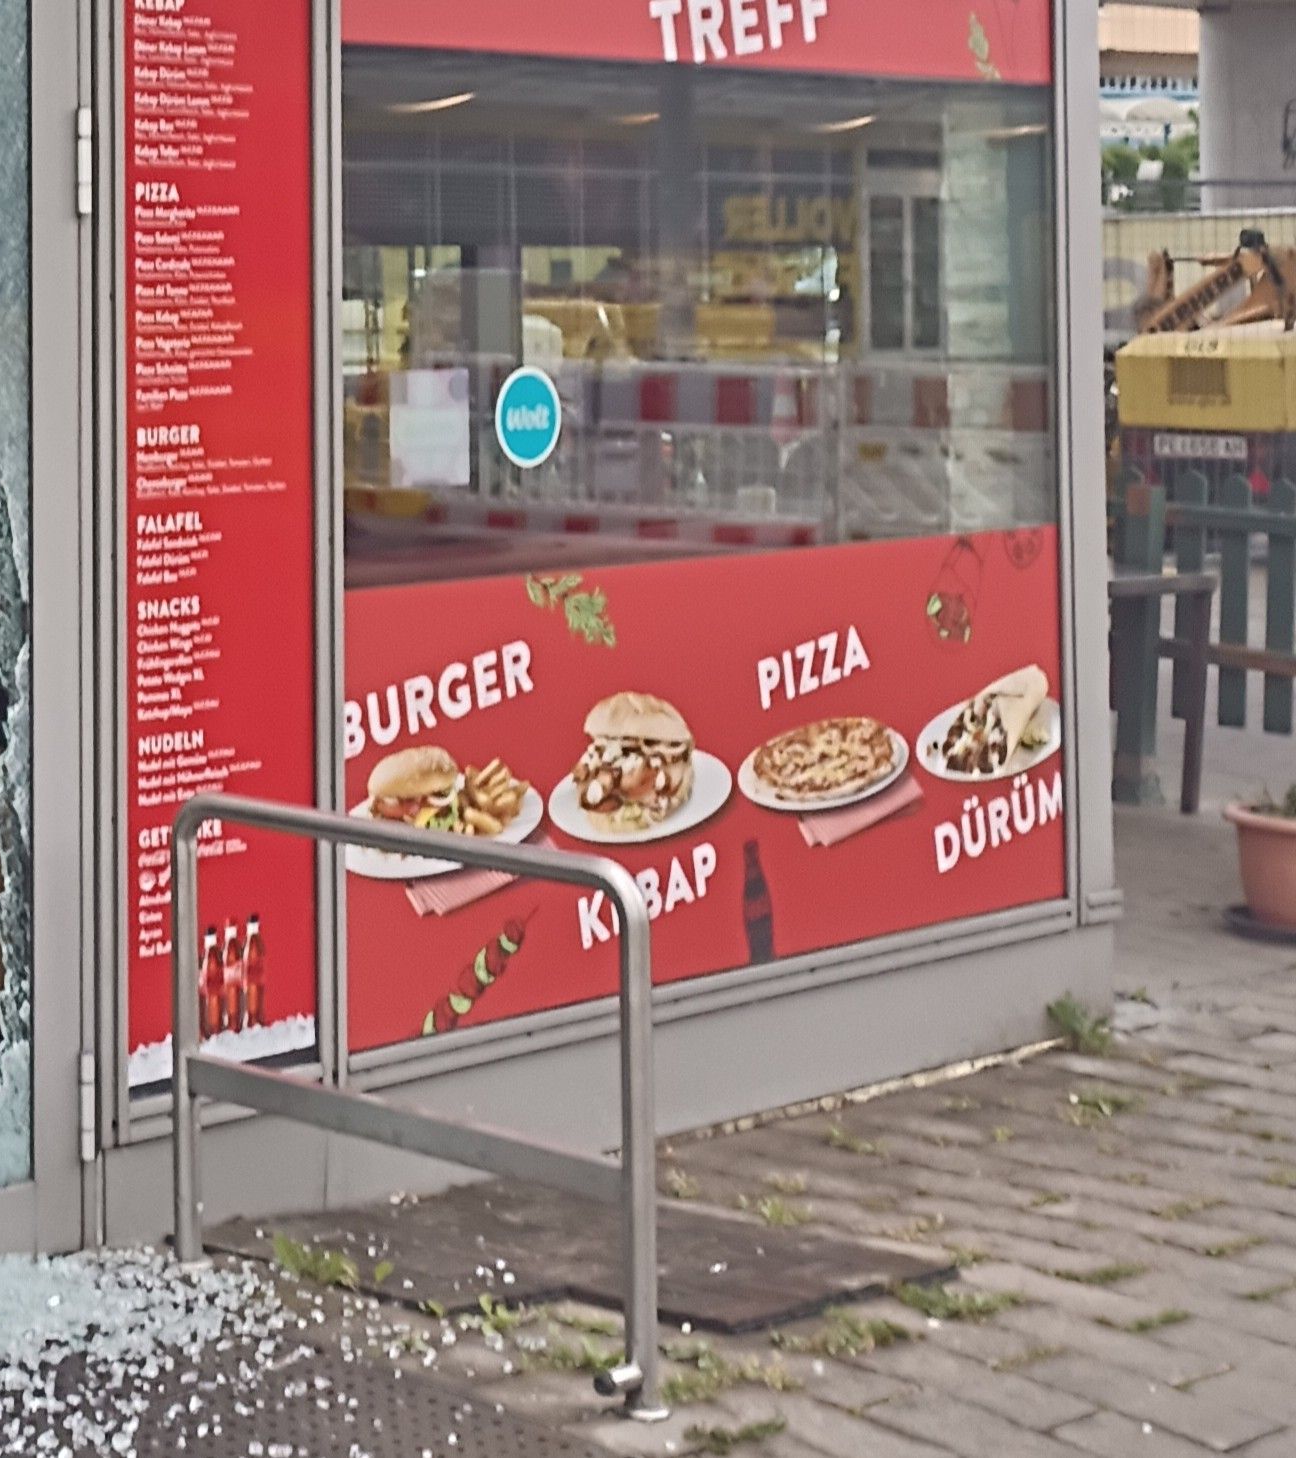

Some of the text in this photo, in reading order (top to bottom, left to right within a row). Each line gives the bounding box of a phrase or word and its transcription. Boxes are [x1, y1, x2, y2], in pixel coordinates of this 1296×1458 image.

[649, 0, 828, 64] TREFF
[135, 182, 180, 202] PIZZA
[137, 424, 200, 447] BURGER
[137, 511, 203, 535] FALAFEL
[137, 595, 200, 620] SNACKS
[758, 625, 870, 710] PIZZA
[344, 640, 534, 759] BURGER
[138, 729, 204, 756] NUDELN
[139, 818, 222, 849] GETKE
[934, 771, 1062, 874] DÜRÜM
[577, 842, 716, 949] KBAP
